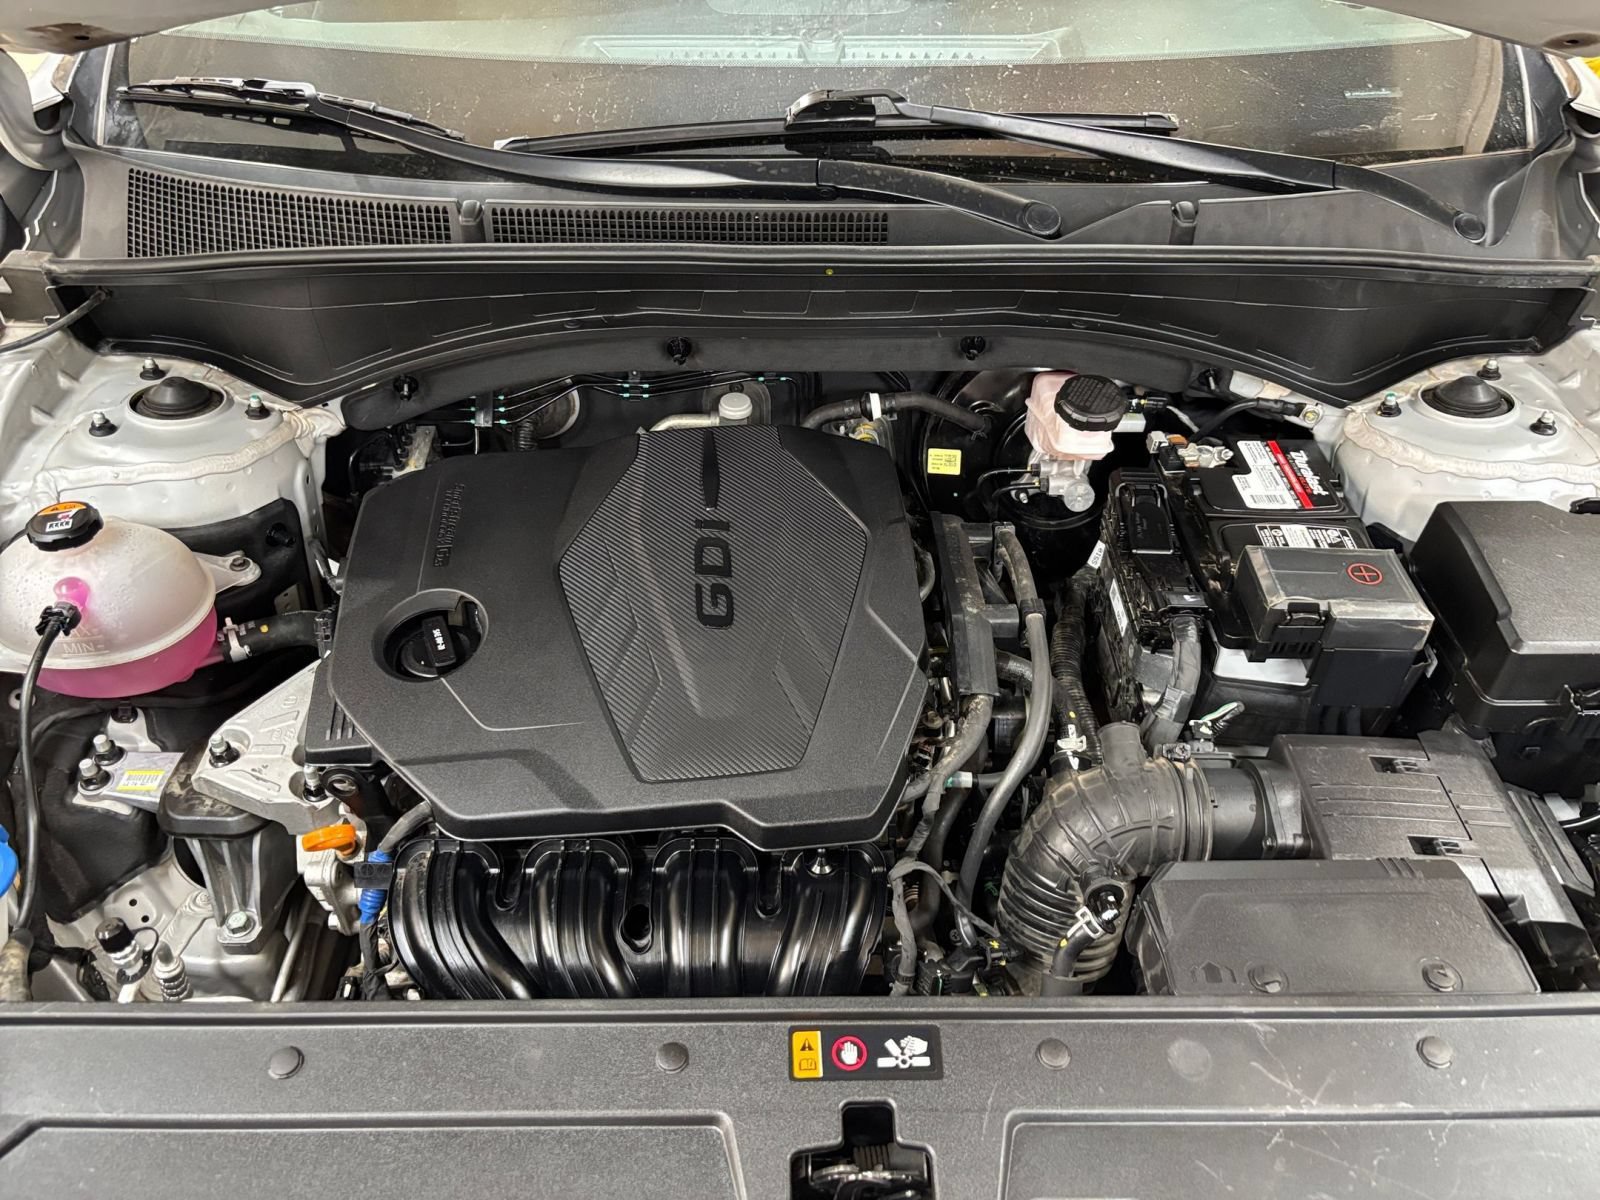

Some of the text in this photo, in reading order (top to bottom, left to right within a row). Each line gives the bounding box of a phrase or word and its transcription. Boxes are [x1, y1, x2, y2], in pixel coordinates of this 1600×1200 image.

[1290, 450, 1329, 495] Duralast
[695, 520, 734, 628] GDI
[63, 643, 95, 654] MIN
